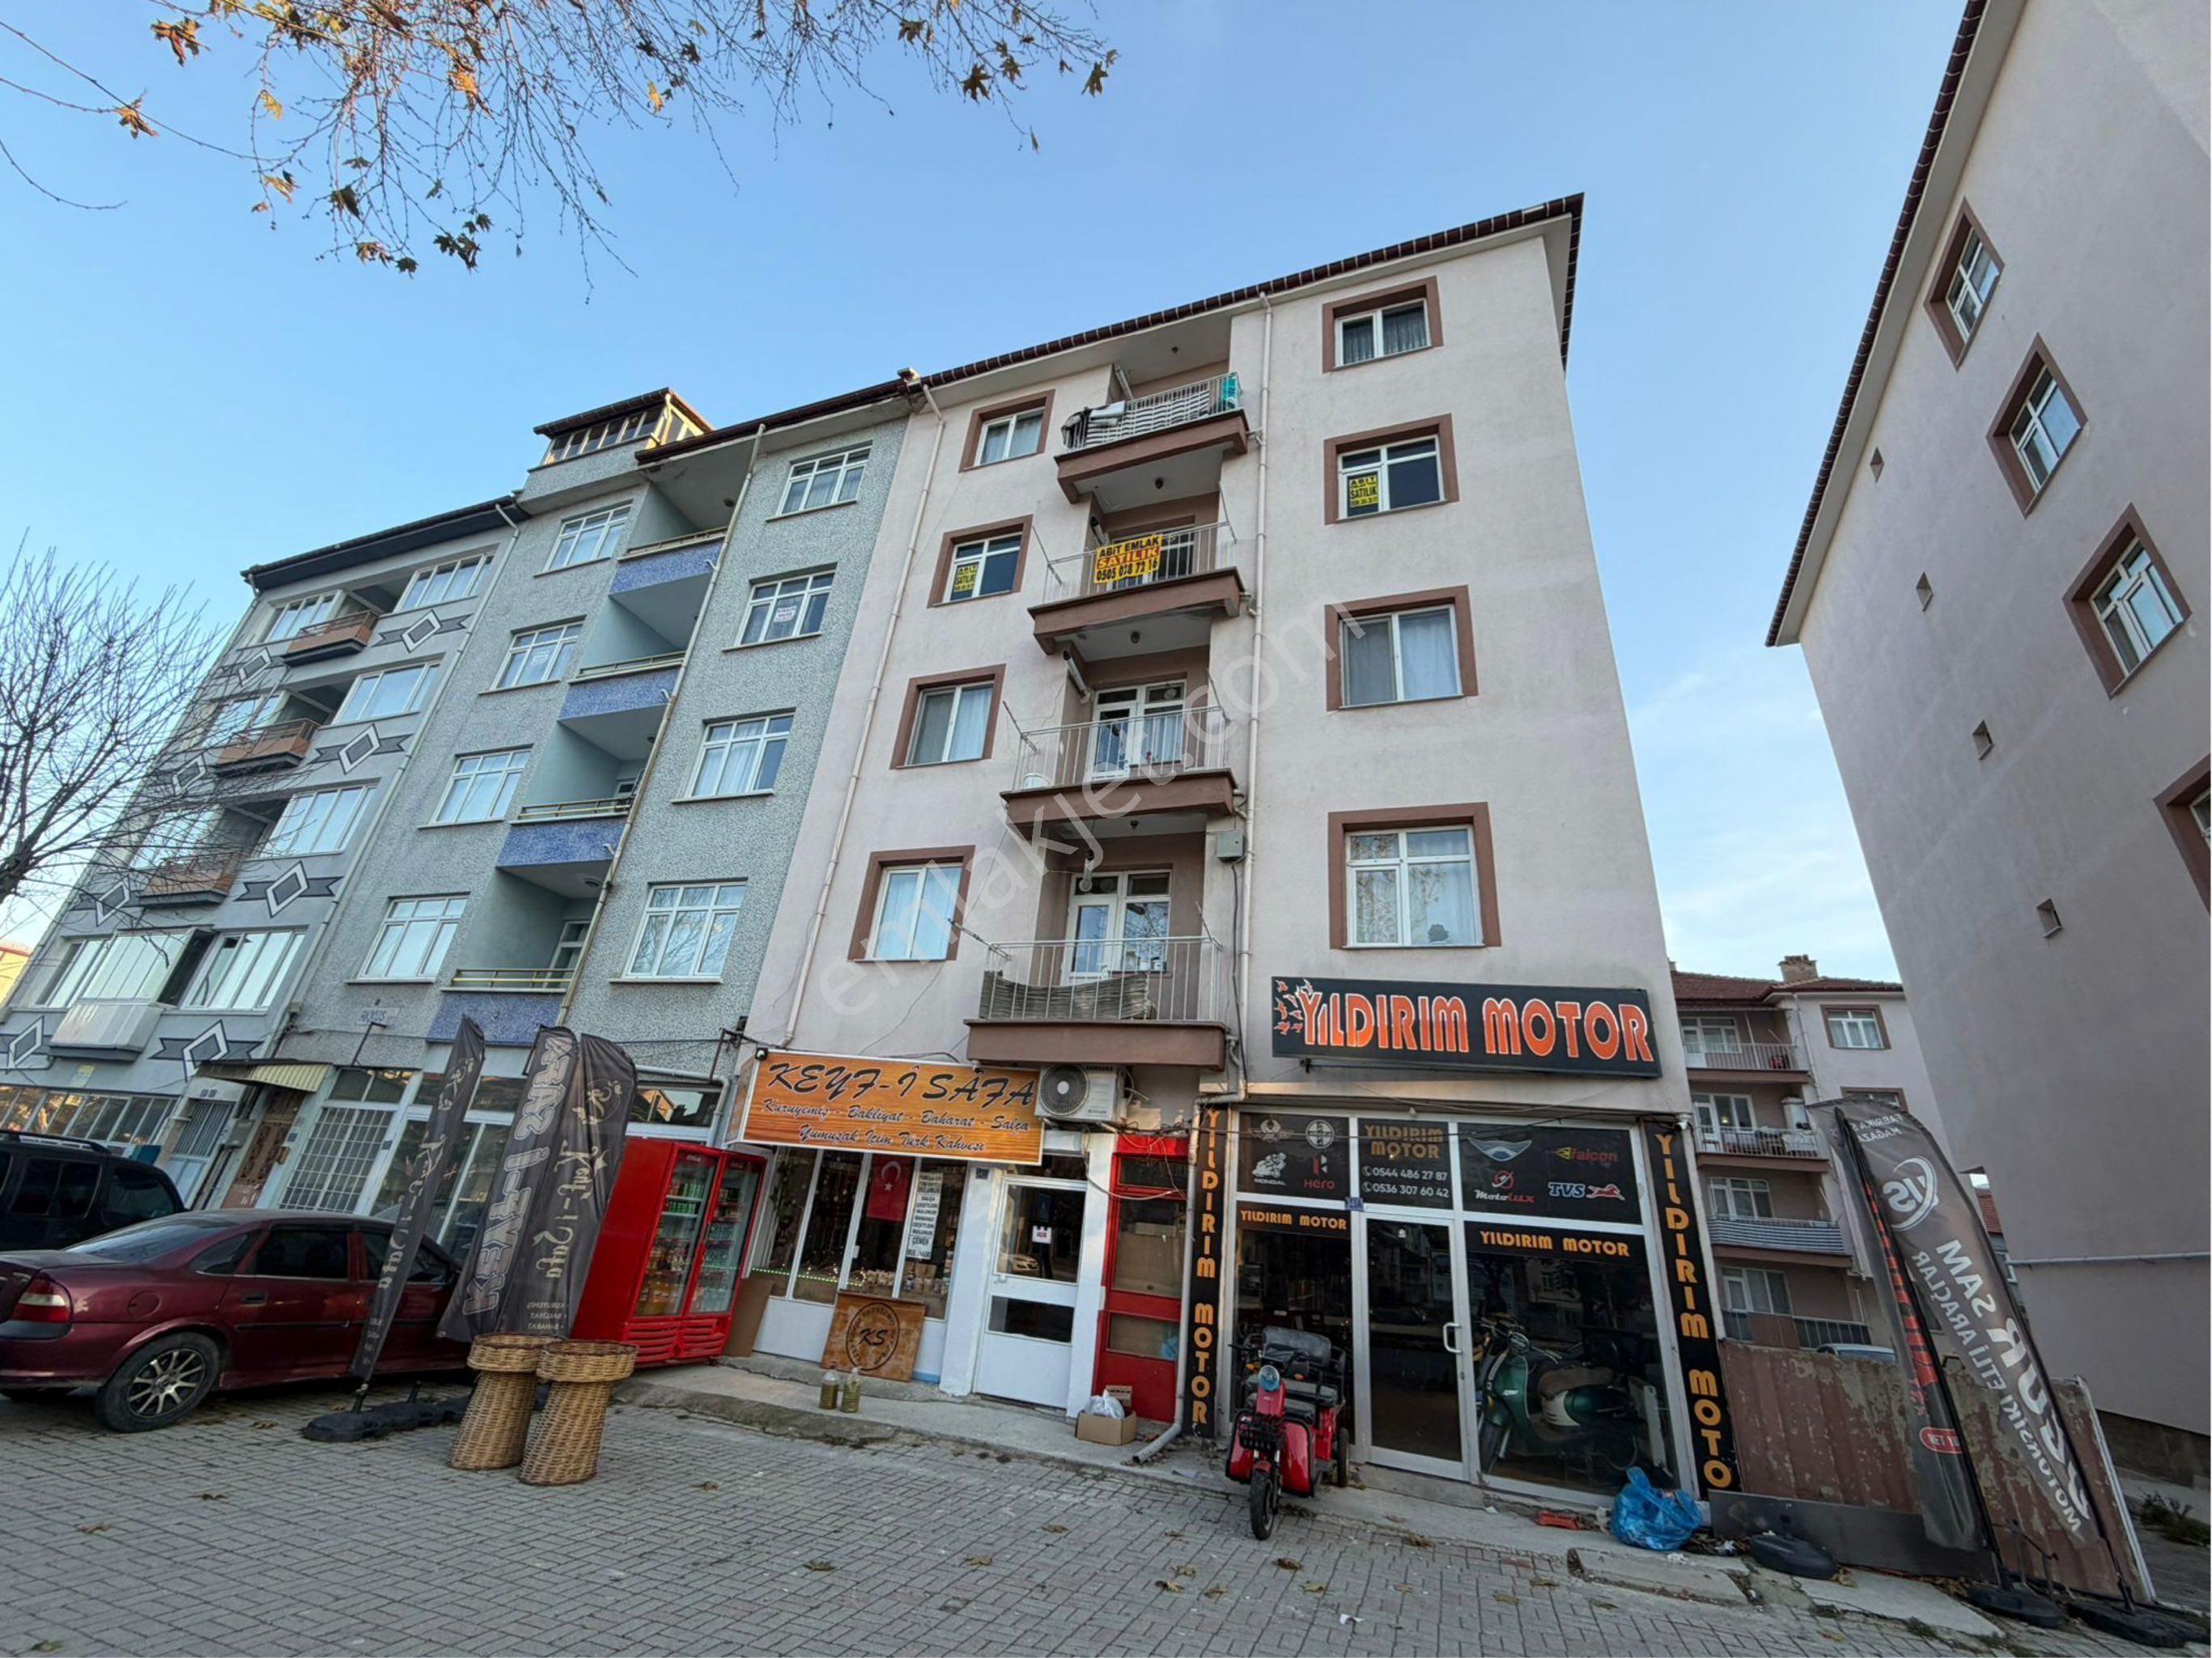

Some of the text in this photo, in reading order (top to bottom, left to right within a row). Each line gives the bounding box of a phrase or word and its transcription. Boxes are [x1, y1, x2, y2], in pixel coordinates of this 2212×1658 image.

[1124, 536, 1159, 551] EMLAK
[1098, 547, 1161, 569] SATILIK
[1096, 567, 1117, 581] 0505
[1136, 561, 1145, 573] 72
[1296, 989, 1654, 1062] YILDIRIM MOTOR
[847, 1104, 904, 1123] Bakliyat
[921, 1109, 974, 1126] Baharat
[991, 1115, 1030, 1133] Salça
[935, 1134, 985, 1151] Kahvesi
[1364, 1125, 1444, 1143] YILDIRIM
[1370, 1141, 1440, 1159] MOTOR
[1572, 1147, 1618, 1163] falcon
[1372, 1167, 1448, 1181] 0544 486 27 87
[1303, 1178, 1335, 1189] Hero
[1372, 1182, 1450, 1198] 0536 307 60 42
[1548, 1181, 1586, 1198] TVS
[1196, 1109, 1221, 1279] YILDIRIM
[1240, 1209, 1348, 1231] YILDIRIM MOTOR
[1480, 1230, 1631, 1257] YILDIRIM MOTOR
[1654, 1133, 1709, 1340] YILDIRIM
[859, 1328, 889, 1346] KS
[1191, 1303, 1214, 1424] MOTOR
